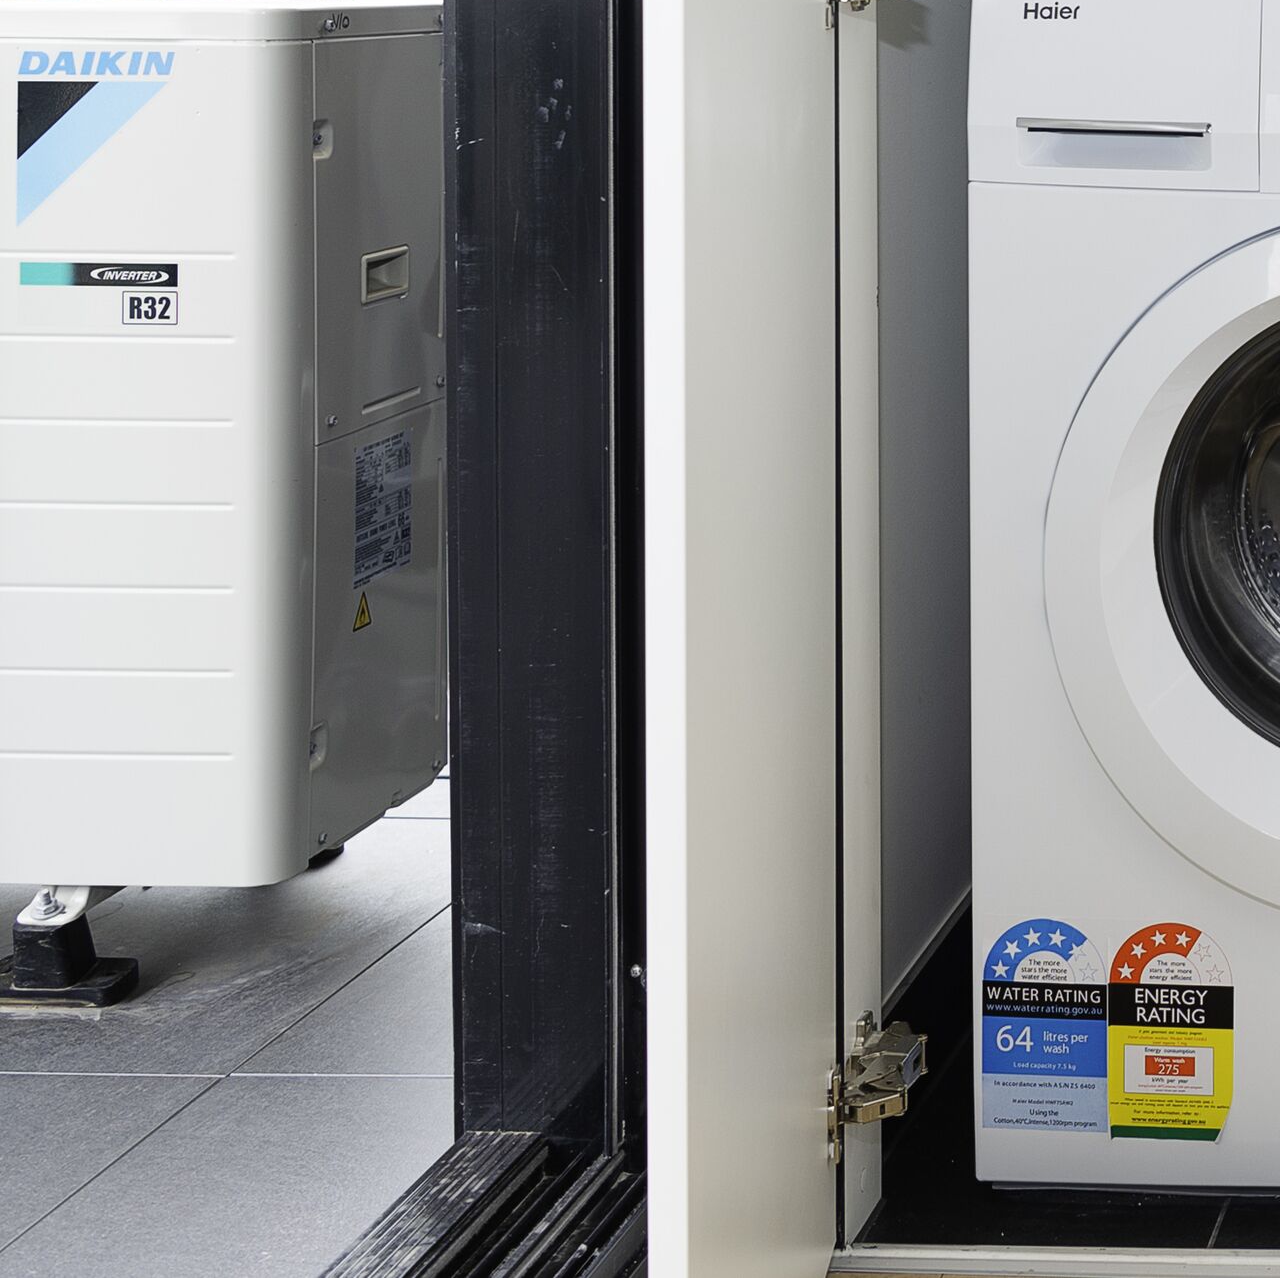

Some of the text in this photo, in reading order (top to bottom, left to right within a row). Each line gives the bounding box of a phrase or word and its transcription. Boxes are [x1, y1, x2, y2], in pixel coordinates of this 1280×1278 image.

[1023, 1, 1080, 20] Haier
[17, 50, 176, 76] DAIKIN
[102, 270, 158, 281] INVERTER
[129, 296, 171, 320] R32
[1038, 966, 1049, 974] the
[1041, 974, 1068, 982] efficient
[987, 986, 1101, 1004] WATER RATING
[1134, 987, 1208, 1006] ENERGY
[986, 1003, 1103, 1016] www.waterrating.gov.au
[1136, 1006, 1206, 1024] RATING
[996, 1025, 1034, 1053] 64
[1043, 1030, 1088, 1045] litres per
[1043, 1043, 1070, 1054] wash
[1030, 1063, 1056, 1071] capacity
[1068, 1063, 1077, 1071] kg
[1158, 1063, 1180, 1075] 275
[1029, 1109, 1048, 1118] Using
